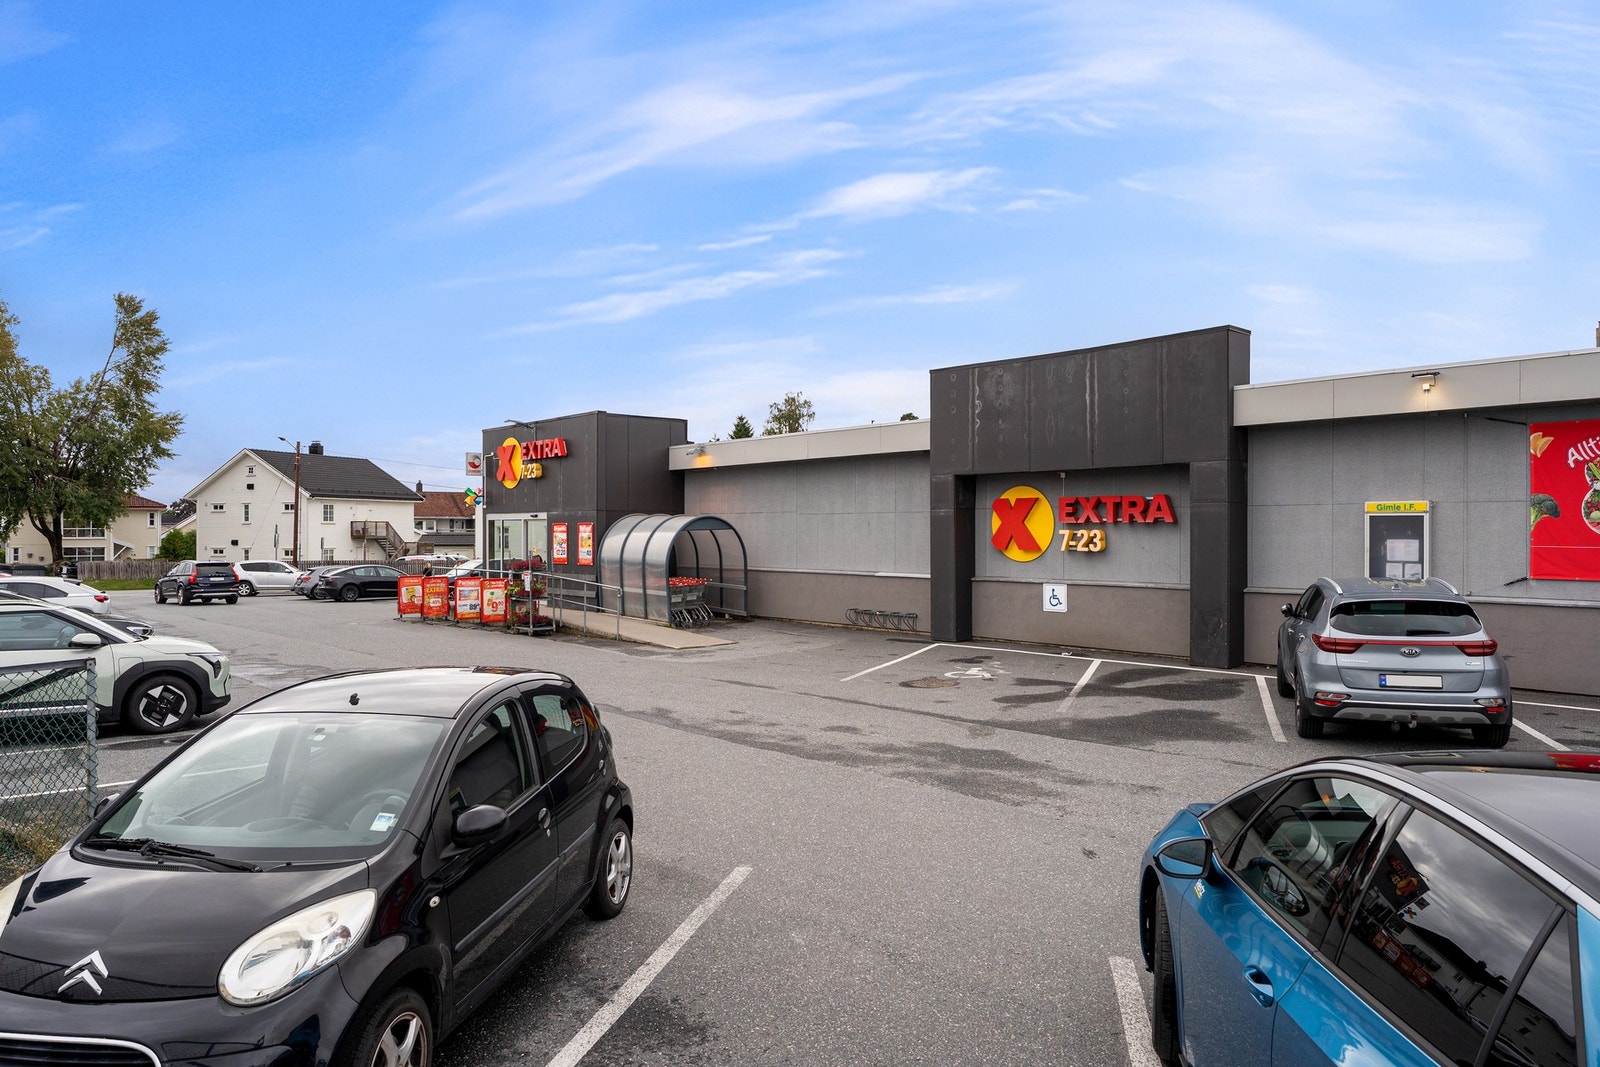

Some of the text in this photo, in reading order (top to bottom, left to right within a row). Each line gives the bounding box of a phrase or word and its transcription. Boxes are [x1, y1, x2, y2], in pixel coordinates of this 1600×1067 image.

[521, 437, 566, 461] EXTRA
[1567, 436, 1600, 468] Allt
[521, 463, 540, 479] 7-23
[1058, 493, 1177, 524] EXTRA
[1376, 503, 1417, 511] Gimle I.F.
[1058, 529, 1106, 552] 7-23
[1402, 648, 1419, 656] KIA
